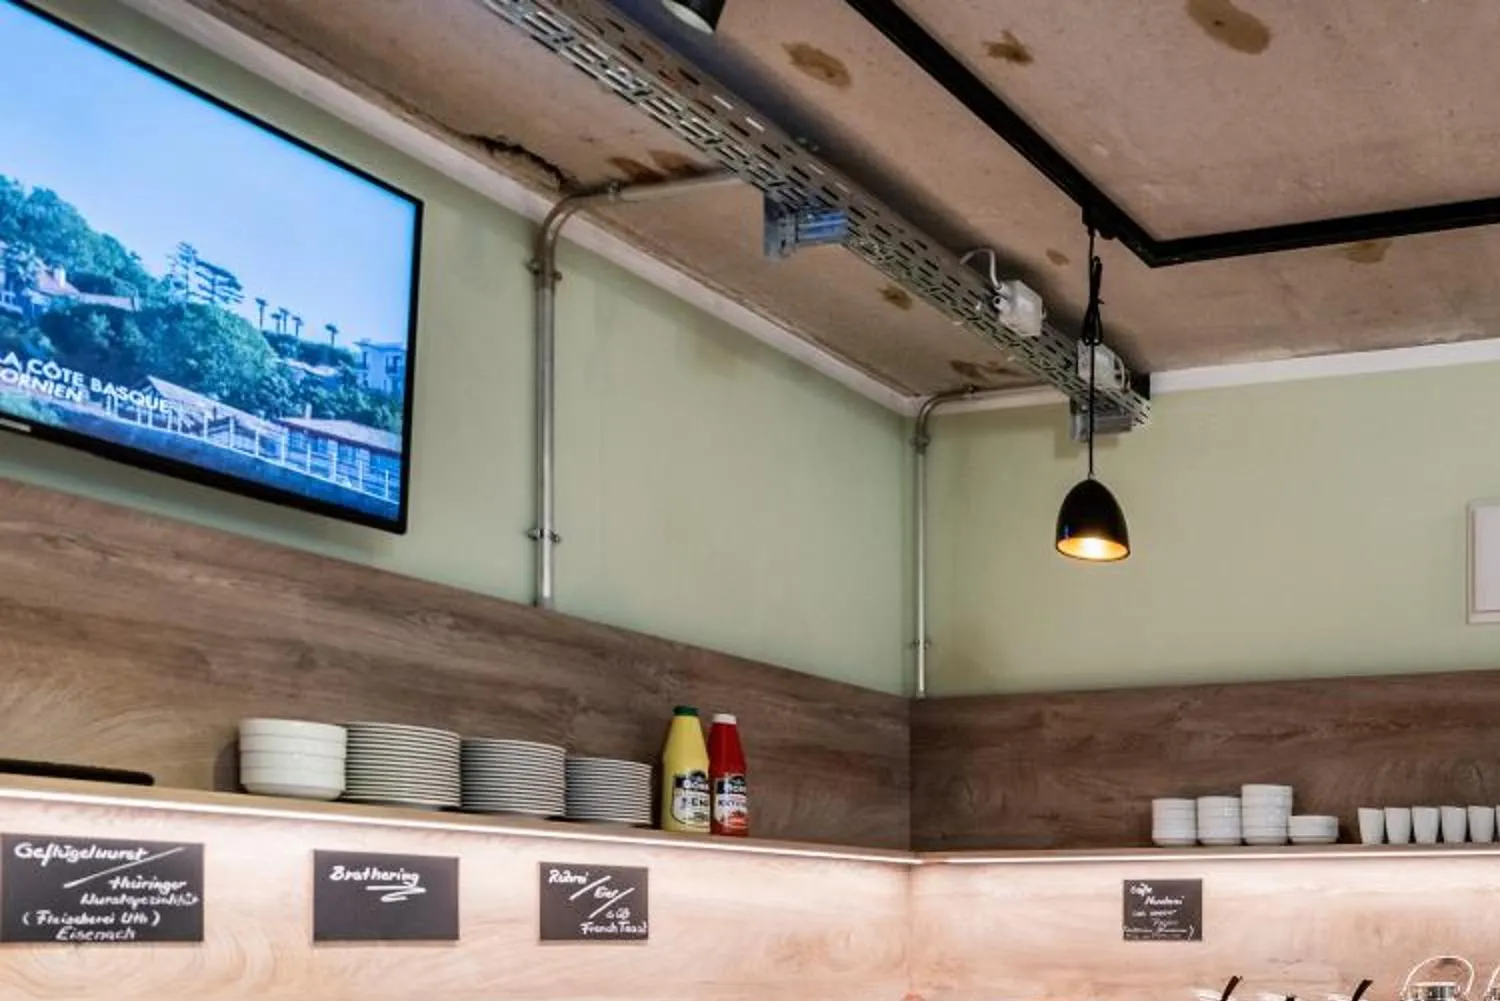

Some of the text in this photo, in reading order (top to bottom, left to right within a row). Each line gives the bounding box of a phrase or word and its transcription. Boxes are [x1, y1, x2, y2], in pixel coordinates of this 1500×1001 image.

[0, 352, 170, 413] A CÔTE BASQUE
